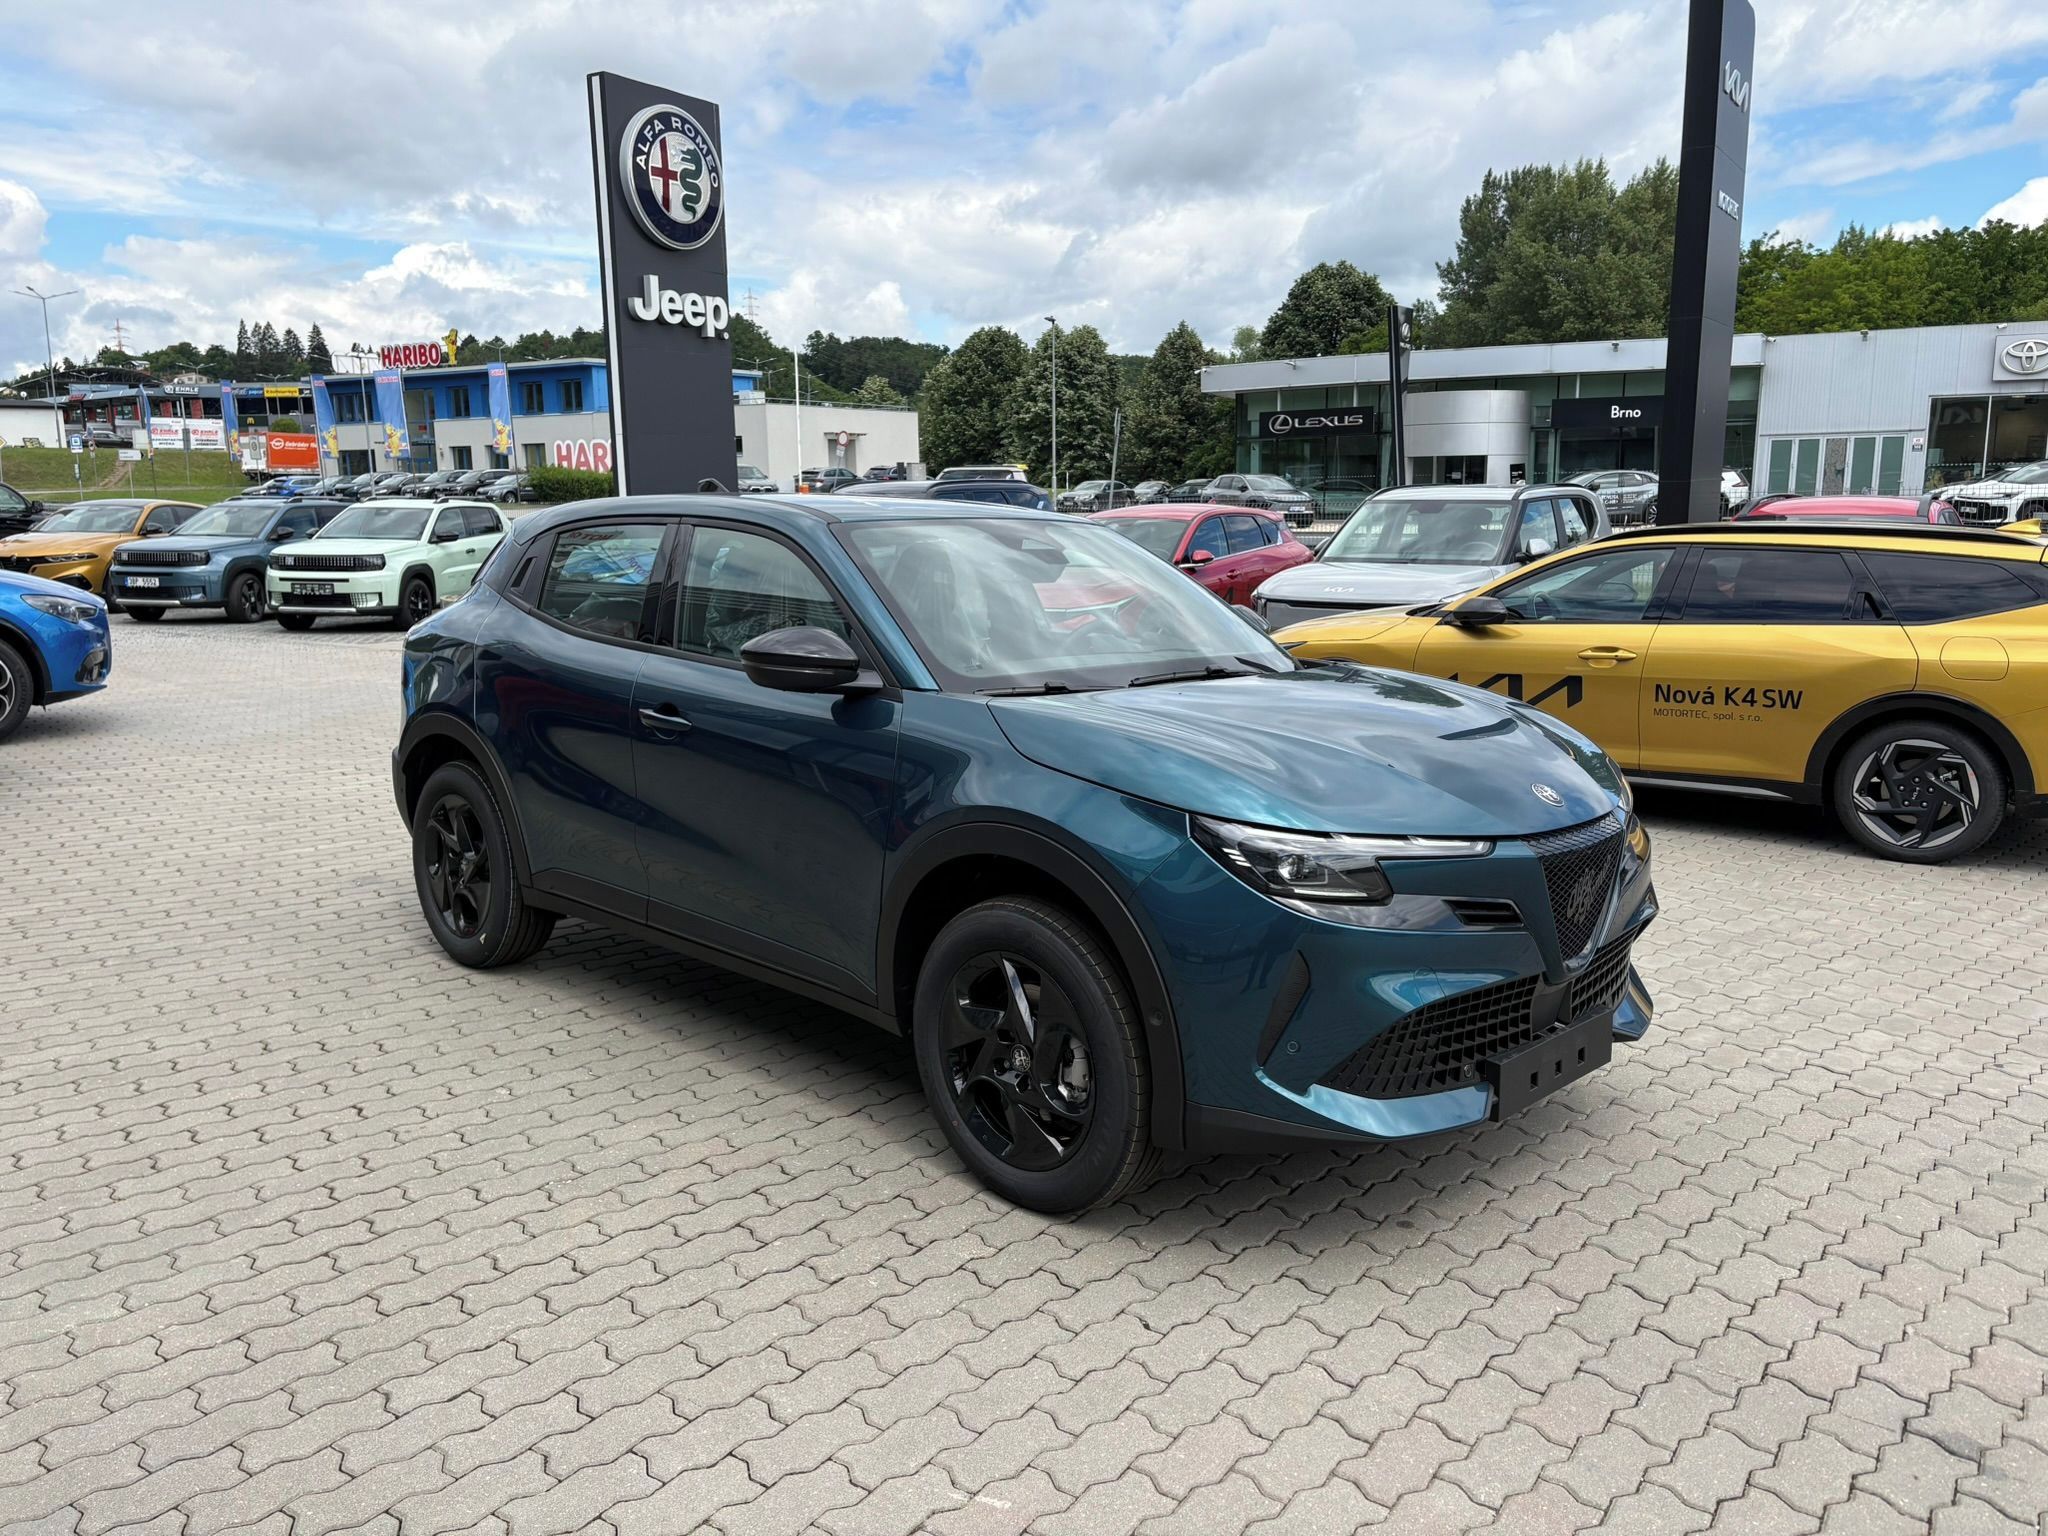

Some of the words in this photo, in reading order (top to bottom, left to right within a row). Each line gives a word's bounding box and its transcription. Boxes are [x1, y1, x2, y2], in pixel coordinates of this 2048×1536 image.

[636, 119, 665, 170] ALFA
[671, 116, 719, 188] ROMEO
[380, 341, 441, 368] HARIBO
[175, 386, 199, 394] EHRLE
[1611, 405, 1641, 418] Brno
[1294, 414, 1363, 428] LEXUS
[1654, 683, 1715, 706] Nová
[1724, 686, 1758, 708] K4
[1761, 688, 1803, 710] SW
[1653, 707, 1710, 721] MOTORTEC,
[1713, 711, 1736, 721] spol.
[1747, 714, 1763, 722] r.o.
